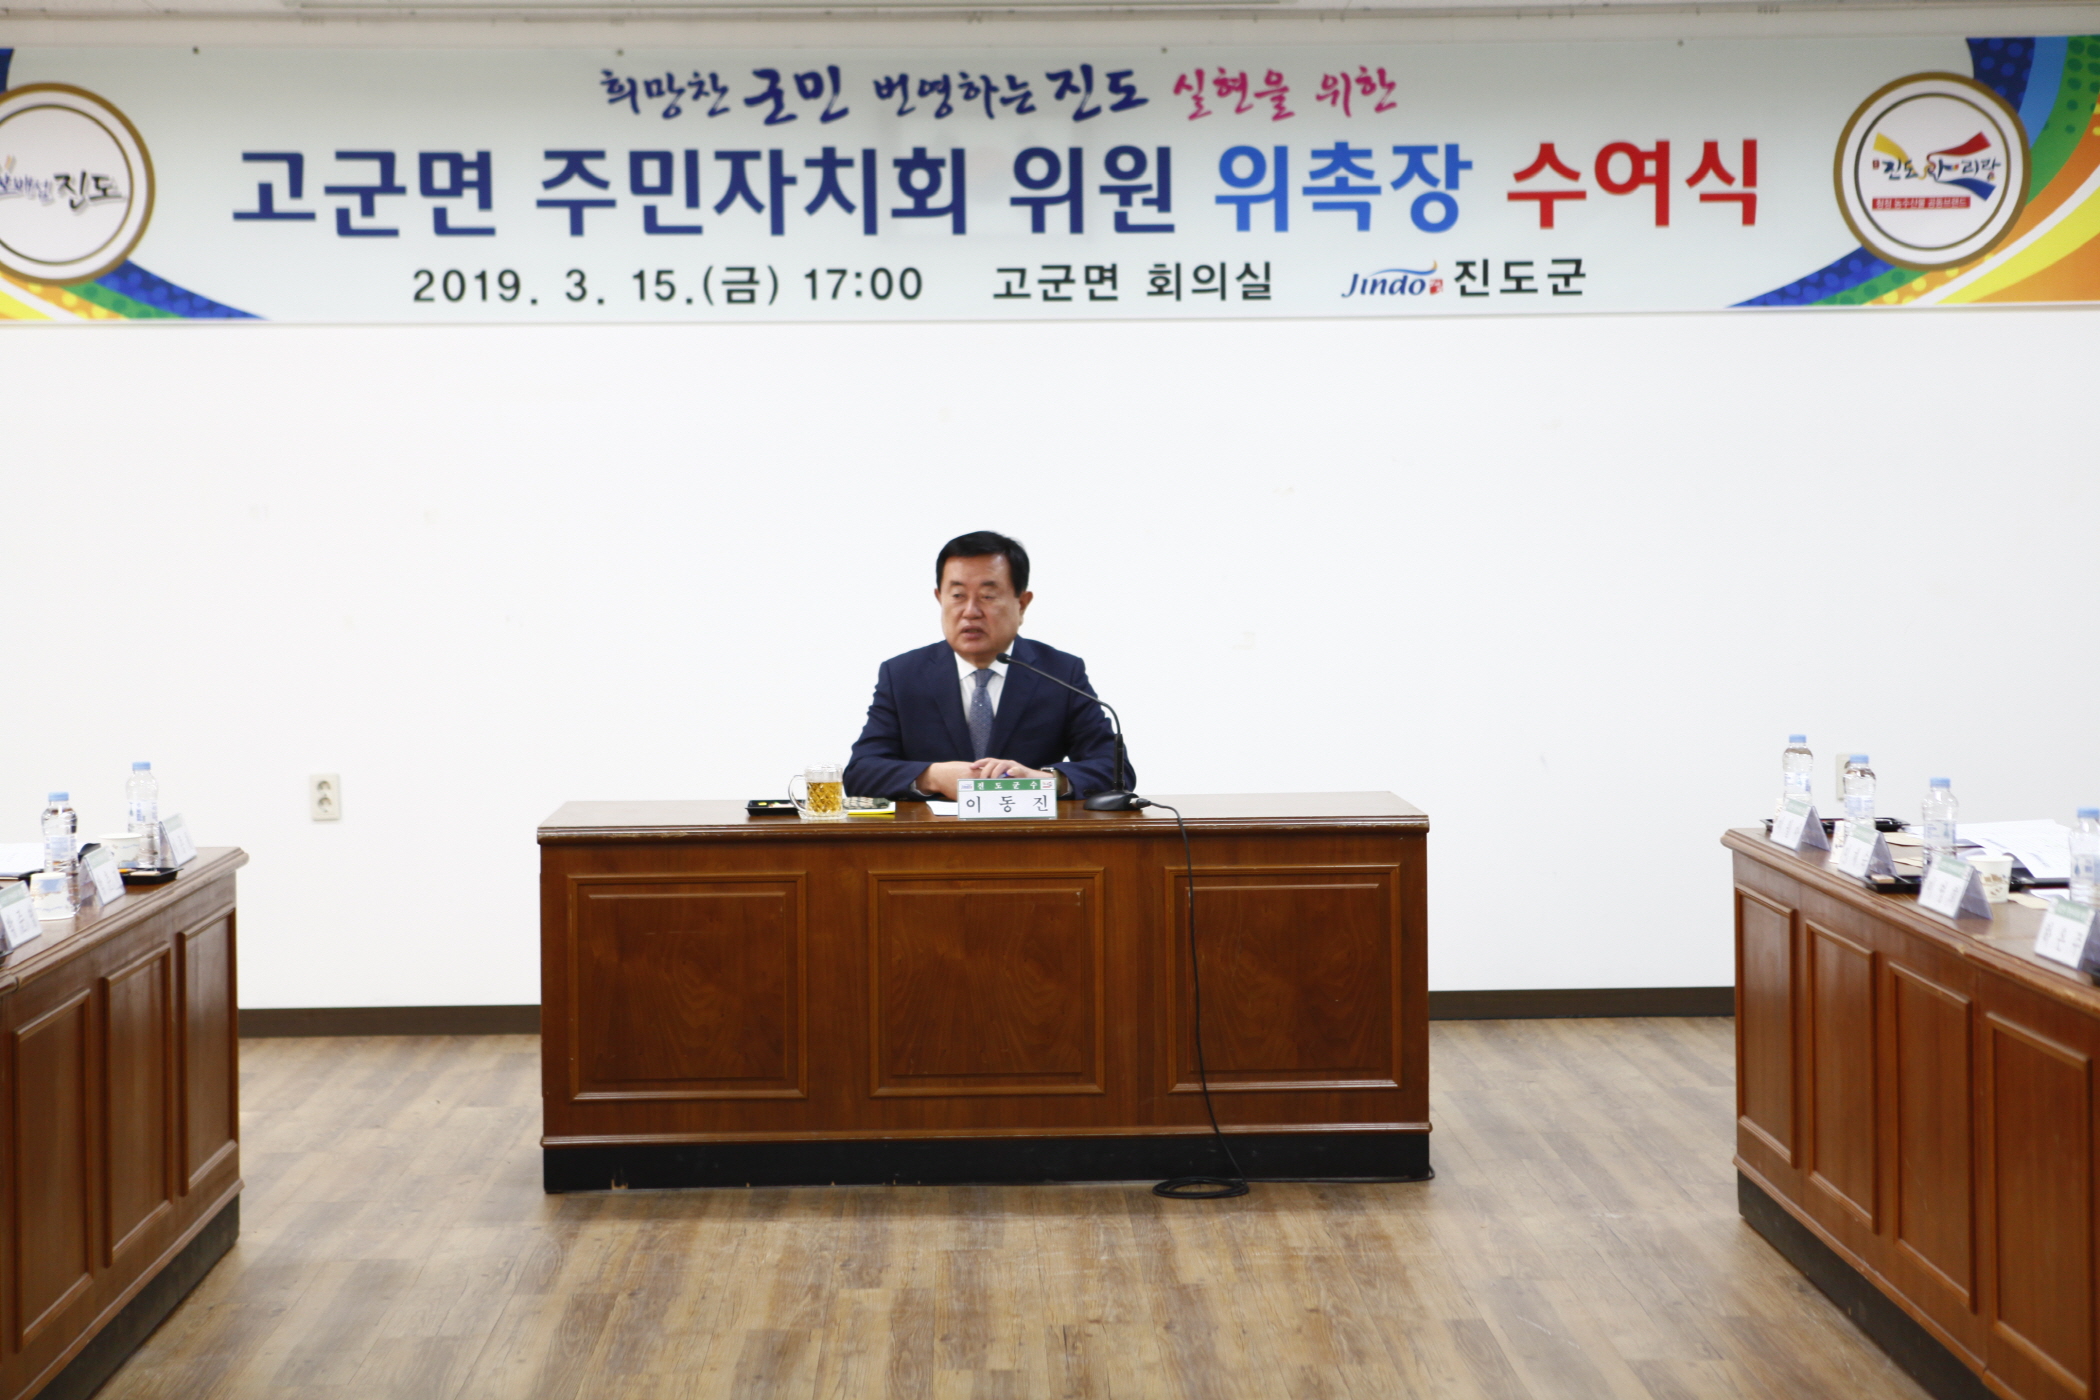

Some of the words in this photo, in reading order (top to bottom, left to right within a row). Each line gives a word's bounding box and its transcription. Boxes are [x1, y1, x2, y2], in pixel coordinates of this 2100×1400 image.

[599, 69, 731, 120] 희망찬
[743, 64, 850, 126] 군민
[1172, 66, 1295, 122] 실현을
[1315, 65, 1397, 118] 위한
[53, 170, 123, 210] 진도
[232, 149, 497, 238] 고군면
[535, 145, 967, 237] 주민자치회
[1009, 144, 1175, 235] 위원
[1214, 140, 1474, 234] 위촉장
[1506, 138, 1758, 230] 수여식
[413, 268, 538, 305] 2019.
[565, 268, 605, 305] 3.
[804, 266, 923, 301] 17:00
[992, 262, 1119, 302] 고군면
[1146, 261, 1272, 302] 회의실
[1341, 272, 1426, 298] Jindo
[1454, 258, 1587, 298] 진도군
